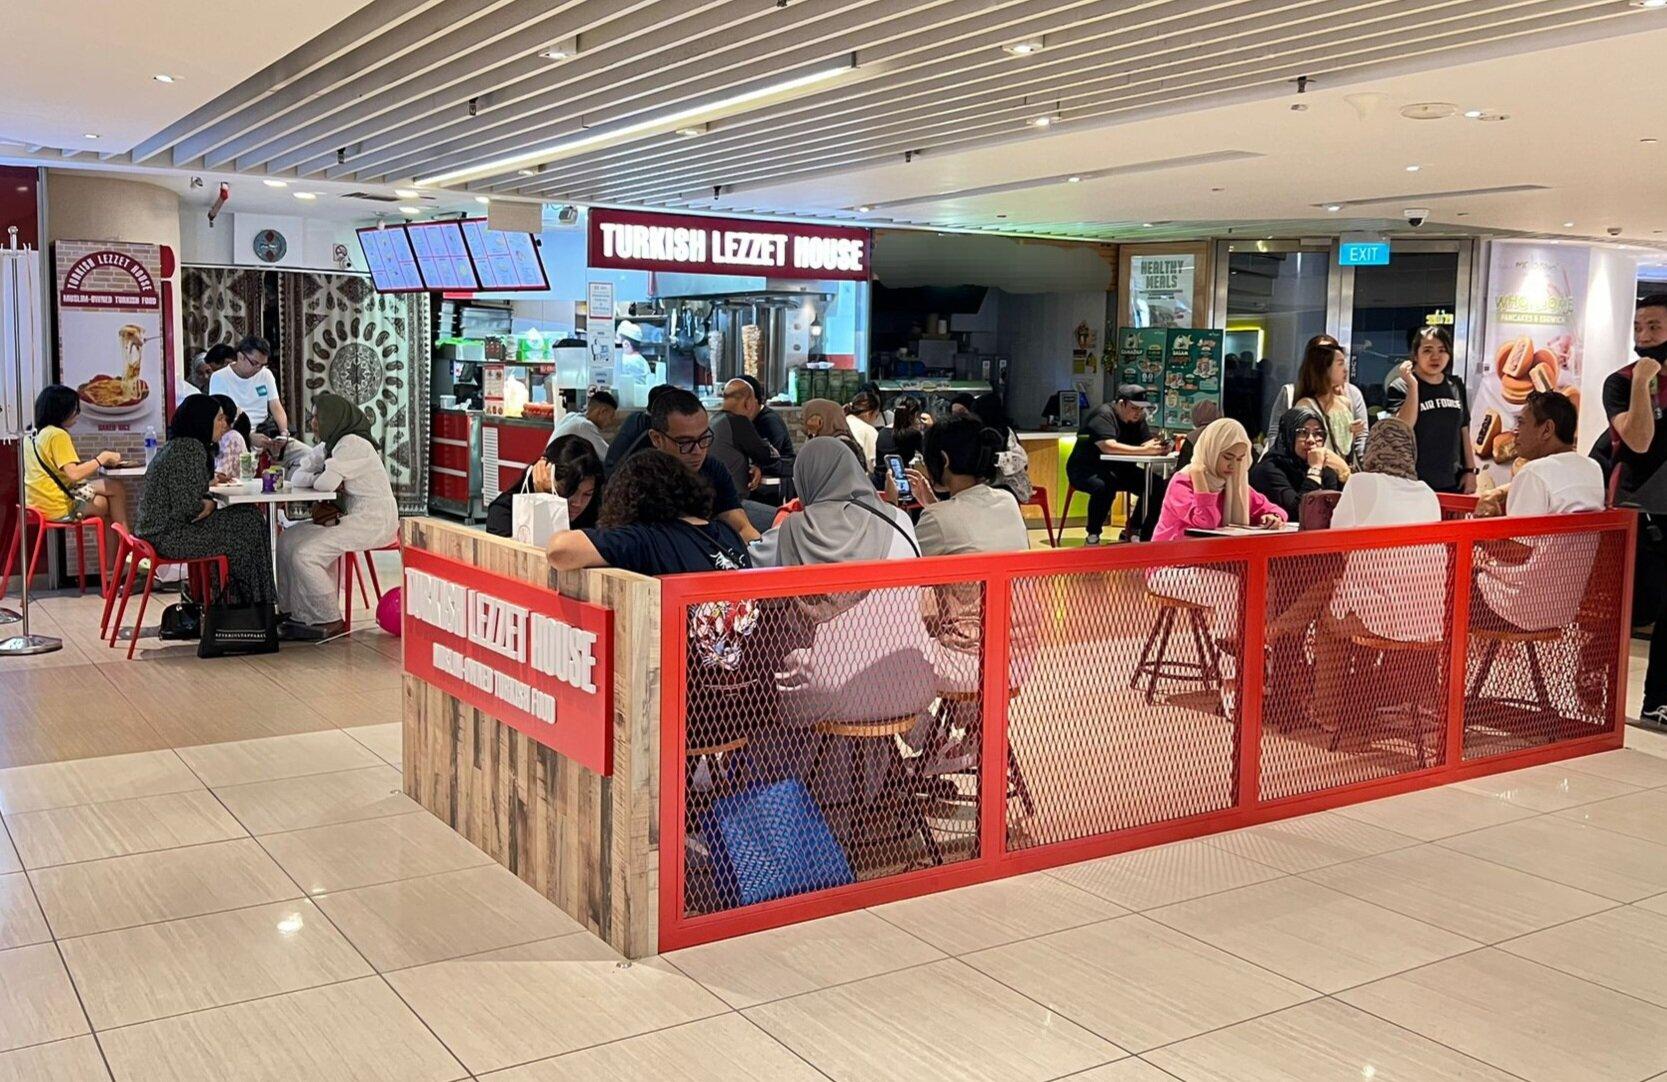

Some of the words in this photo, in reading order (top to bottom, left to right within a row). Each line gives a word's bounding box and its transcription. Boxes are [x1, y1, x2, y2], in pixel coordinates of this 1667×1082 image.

[599, 223, 706, 262] TURKISH
[712, 230, 788, 266] LEZZET
[794, 236, 864, 271] HOUSE
[1350, 248, 1378, 261] EXIT
[67, 258, 96, 289] TURKISH
[97, 254, 130, 268] LEZZET
[130, 265, 153, 291] HOUSE
[141, 297, 157, 305] FOOD
[1420, 400, 1435, 411] AIR
[1436, 398, 1461, 410] FORCE
[405, 567, 467, 638] TURKISH
[468, 589, 529, 663] LEZZET
[530, 611, 597, 694] HOUSE
